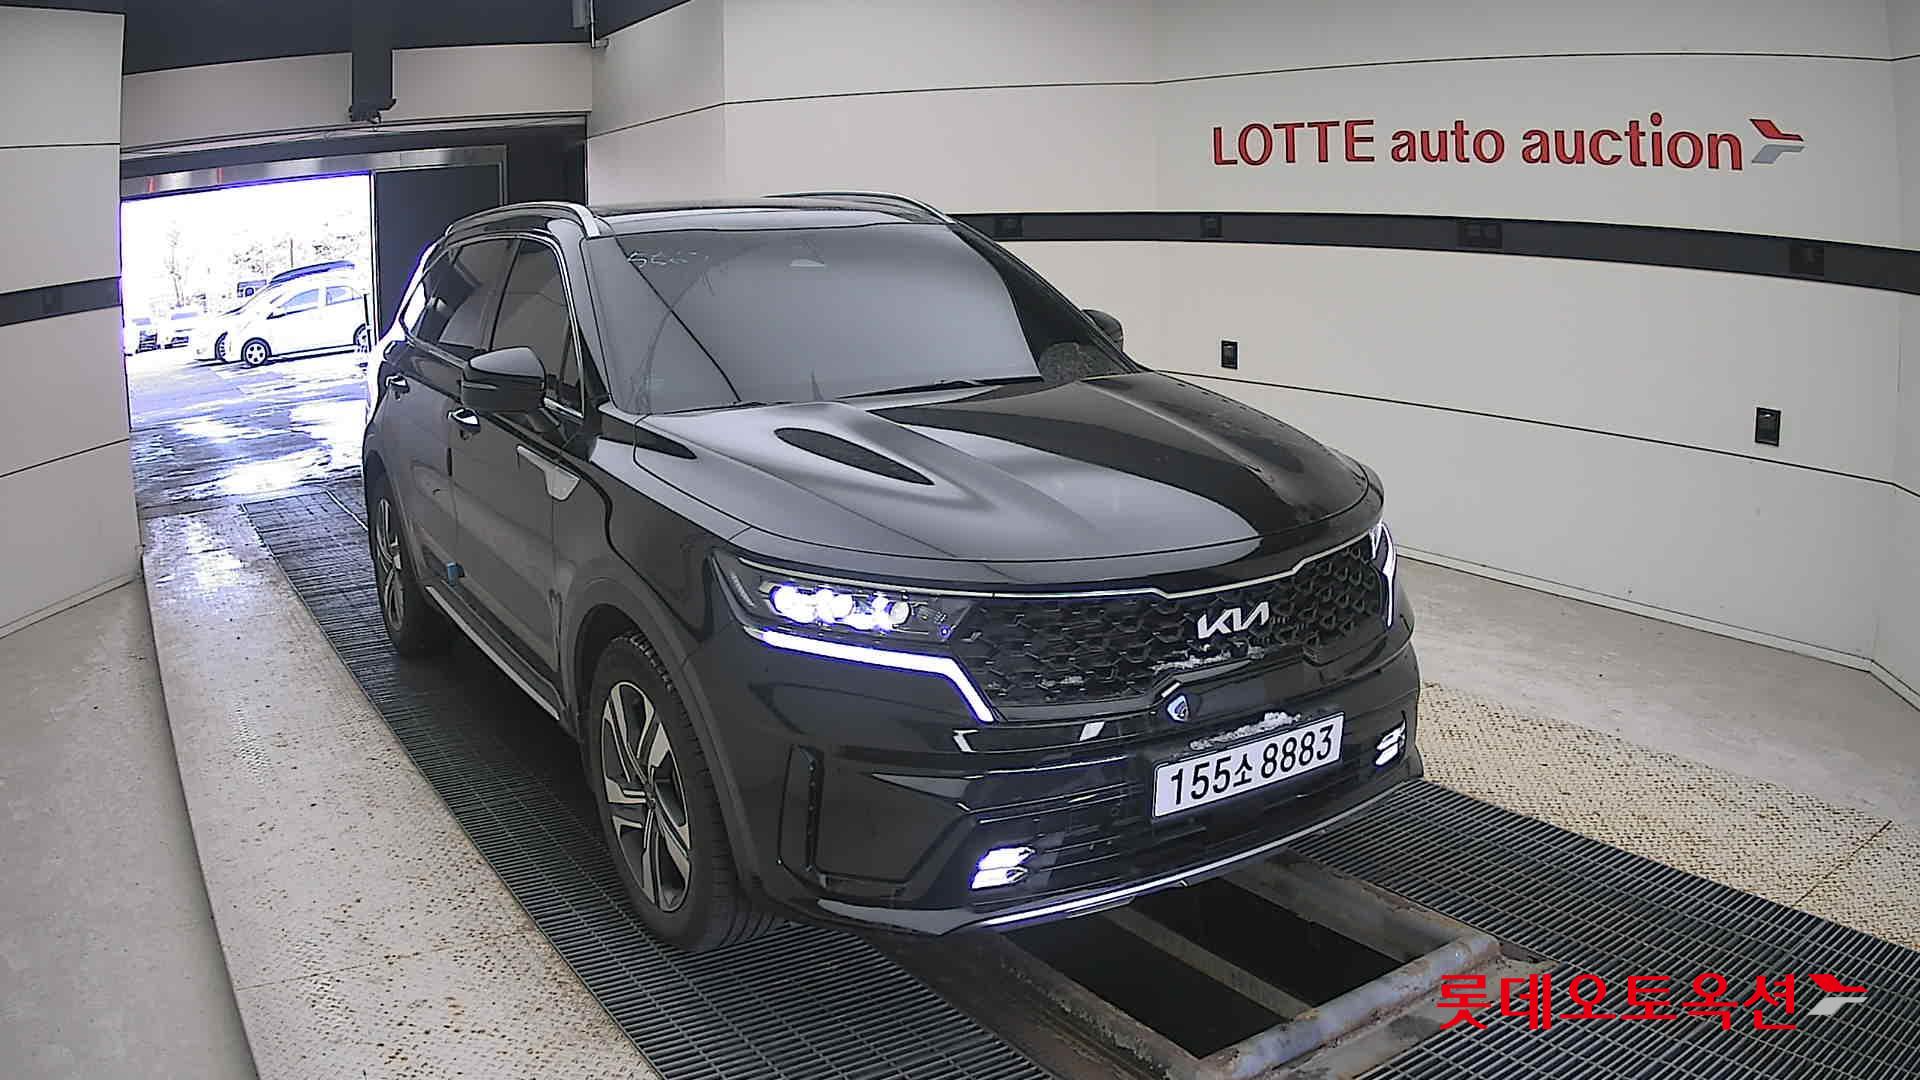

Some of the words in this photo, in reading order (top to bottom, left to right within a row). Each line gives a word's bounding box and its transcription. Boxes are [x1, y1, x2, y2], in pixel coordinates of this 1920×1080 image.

[1212, 119, 1376, 166] LOTTE
[1391, 120, 1505, 163] auto
[1521, 112, 1744, 170] auction
[1197, 601, 1269, 639] KIA
